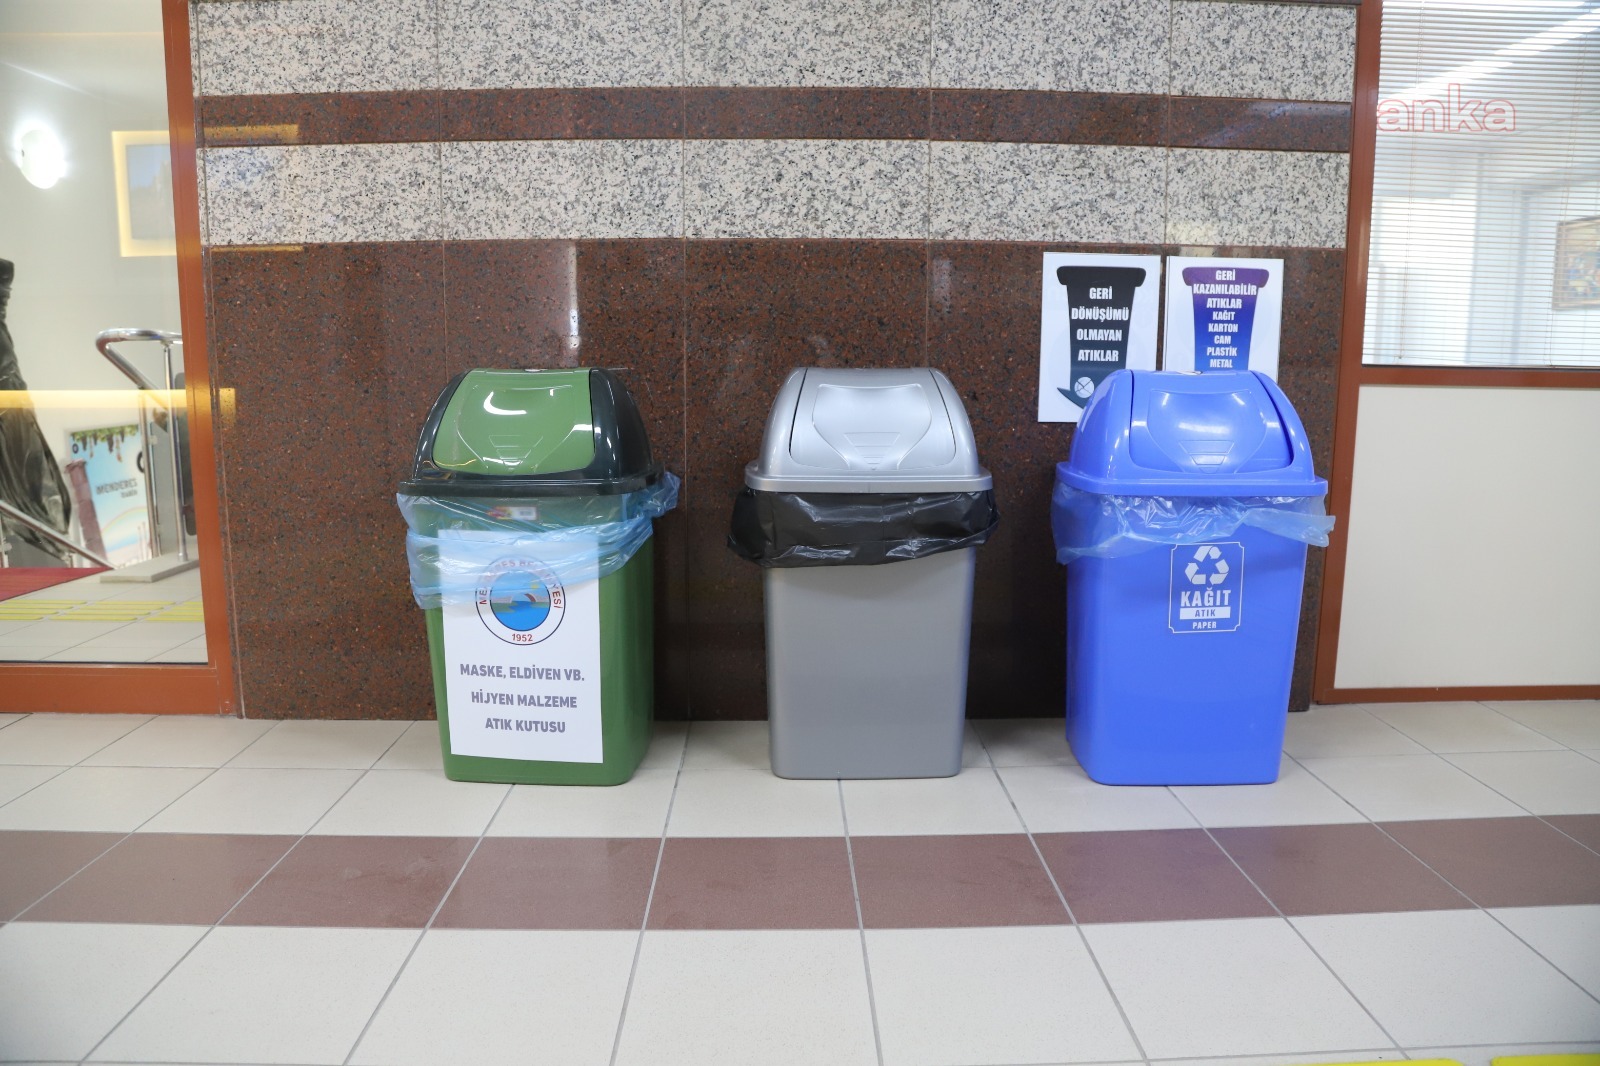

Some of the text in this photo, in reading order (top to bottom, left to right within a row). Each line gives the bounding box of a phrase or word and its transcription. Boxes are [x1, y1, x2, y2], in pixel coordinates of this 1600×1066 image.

[1215, 269, 1236, 281] GERİ
[1089, 286, 1113, 300] GERİ
[1193, 283, 1257, 295] KAZANILABİLİR
[1206, 297, 1243, 309] ATIKLAR
[1071, 306, 1130, 322] DÖNÜŞÜMÜ
[1212, 310, 1236, 321] KAĞIT
[1208, 323, 1239, 333] KARTON
[1076, 328, 1123, 341] OLMAYAN
[1214, 335, 1232, 345] CAM
[1077, 349, 1119, 362] ATIKLAR
[1206, 346, 1238, 356] PLASTİK
[1209, 359, 1233, 368] METAL
[1180, 586, 1232, 607] KAĞIT
[1194, 608, 1216, 618] ATIK
[1192, 621, 1217, 629] PAPER
[511, 633, 533, 642] 1952
[460, 663, 585, 681] MASKE, ELDİVEN VB.
[471, 689, 578, 708] HİJYEN MALZEME
[485, 717, 566, 733] ATIK KUTUSU
